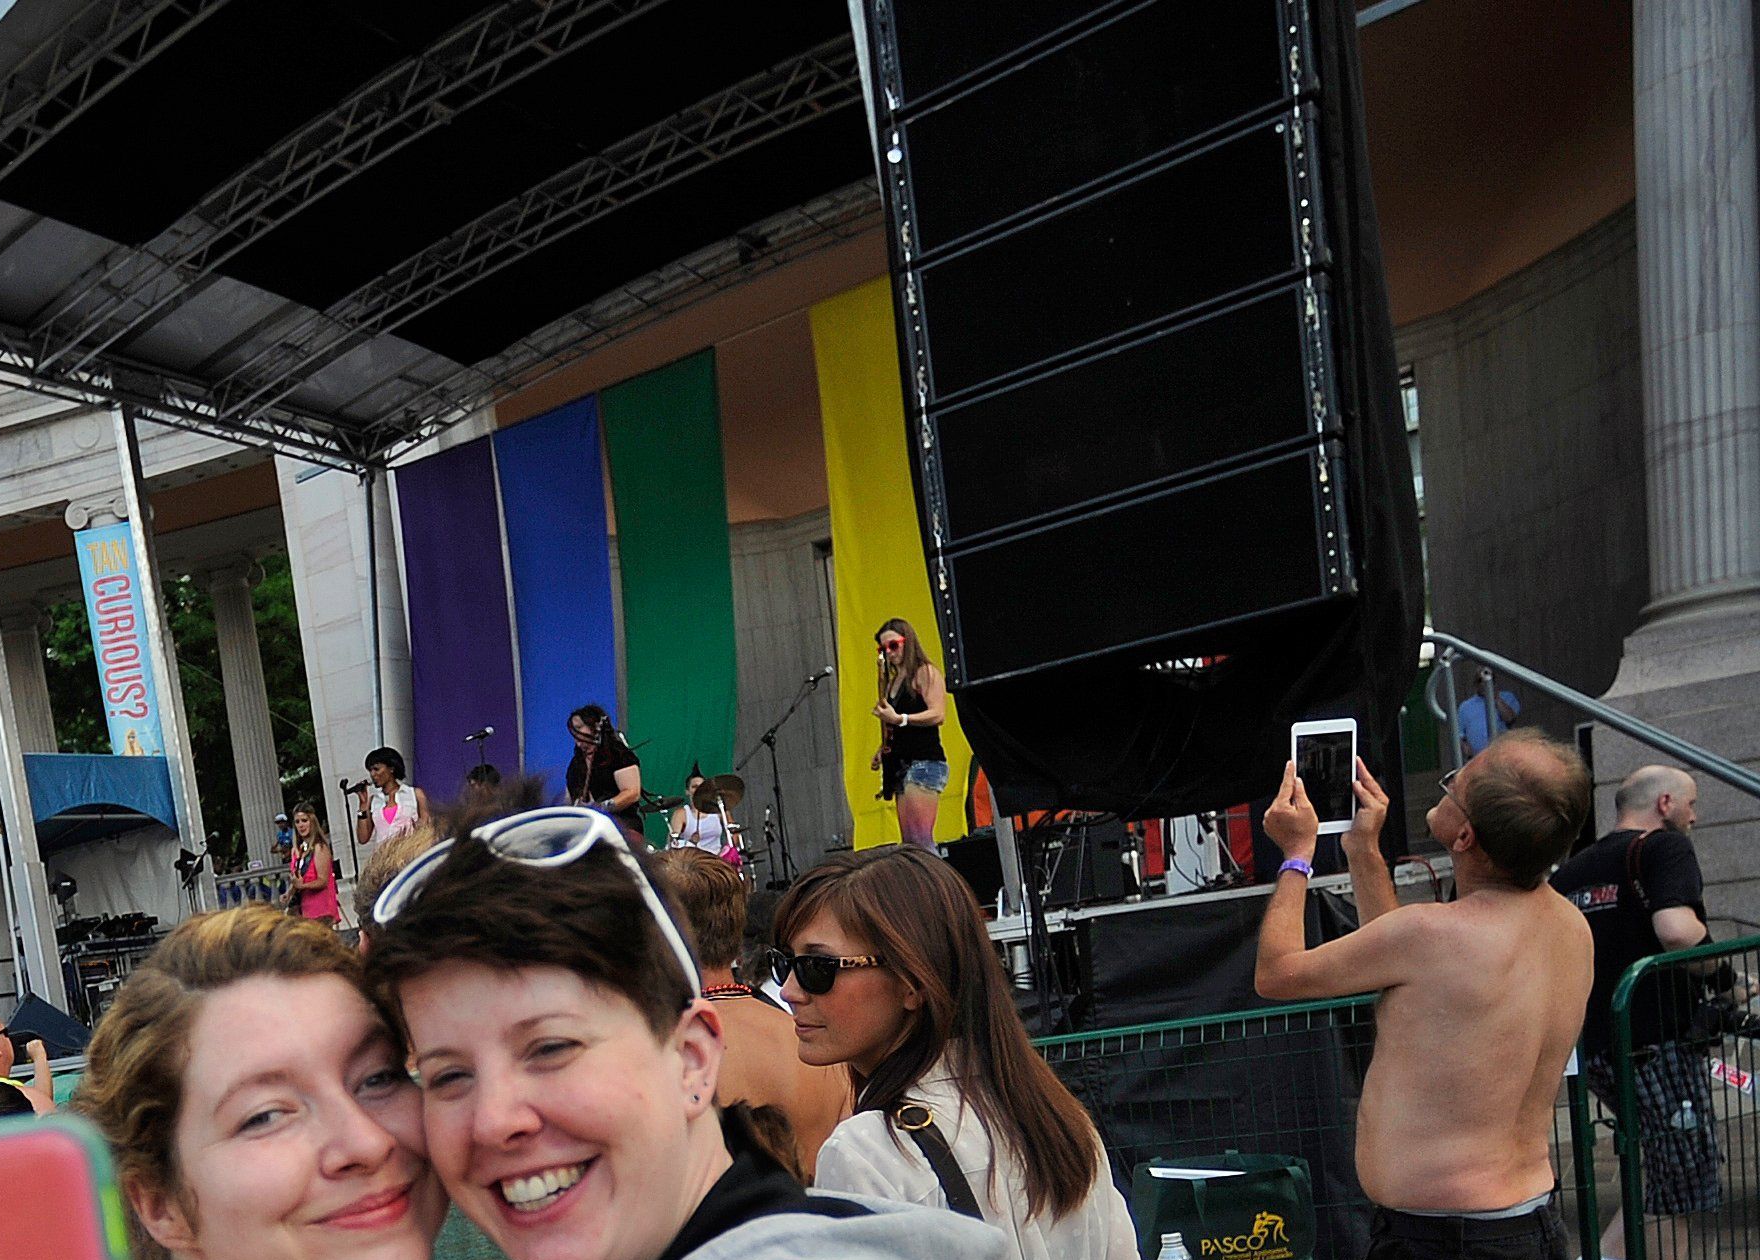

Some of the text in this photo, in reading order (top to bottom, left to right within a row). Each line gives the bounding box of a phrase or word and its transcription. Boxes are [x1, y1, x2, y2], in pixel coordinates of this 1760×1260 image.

[87, 535, 129, 576] TAN
[92, 574, 149, 720] CURIOUS?
[1200, 1234, 1265, 1256] PASCO
